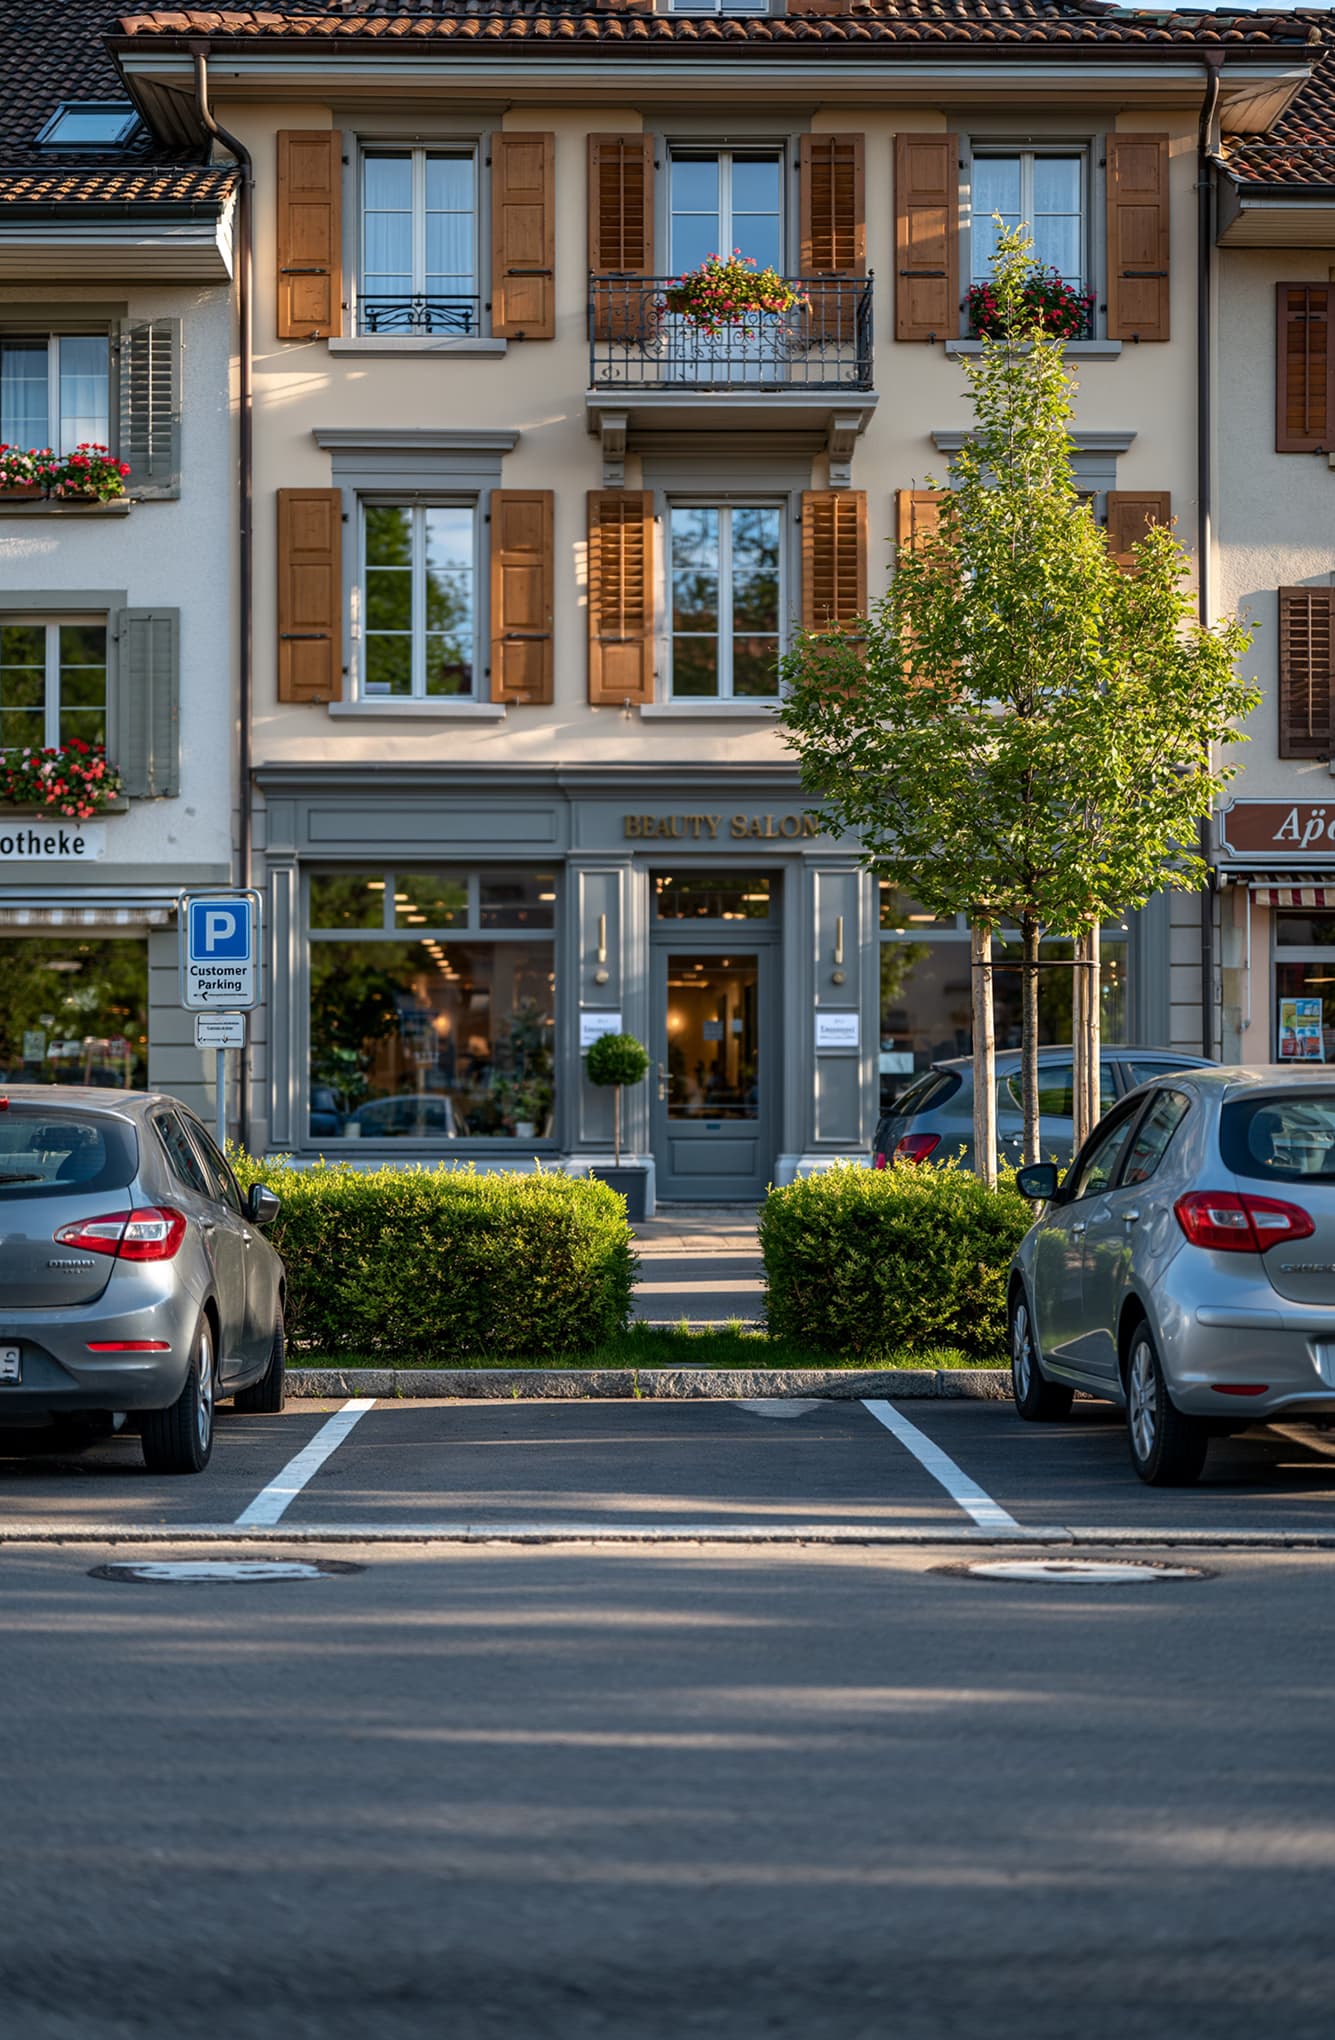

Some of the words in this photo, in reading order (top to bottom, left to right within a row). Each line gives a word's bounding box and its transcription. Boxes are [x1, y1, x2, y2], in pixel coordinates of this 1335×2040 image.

[623, 815, 721, 839] BEAUTY
[730, 815, 820, 839] SALON
[0, 829, 85, 855] otheke
[205, 911, 236, 952] P
[190, 965, 248, 977] Customer
[198, 979, 242, 991] Parking
